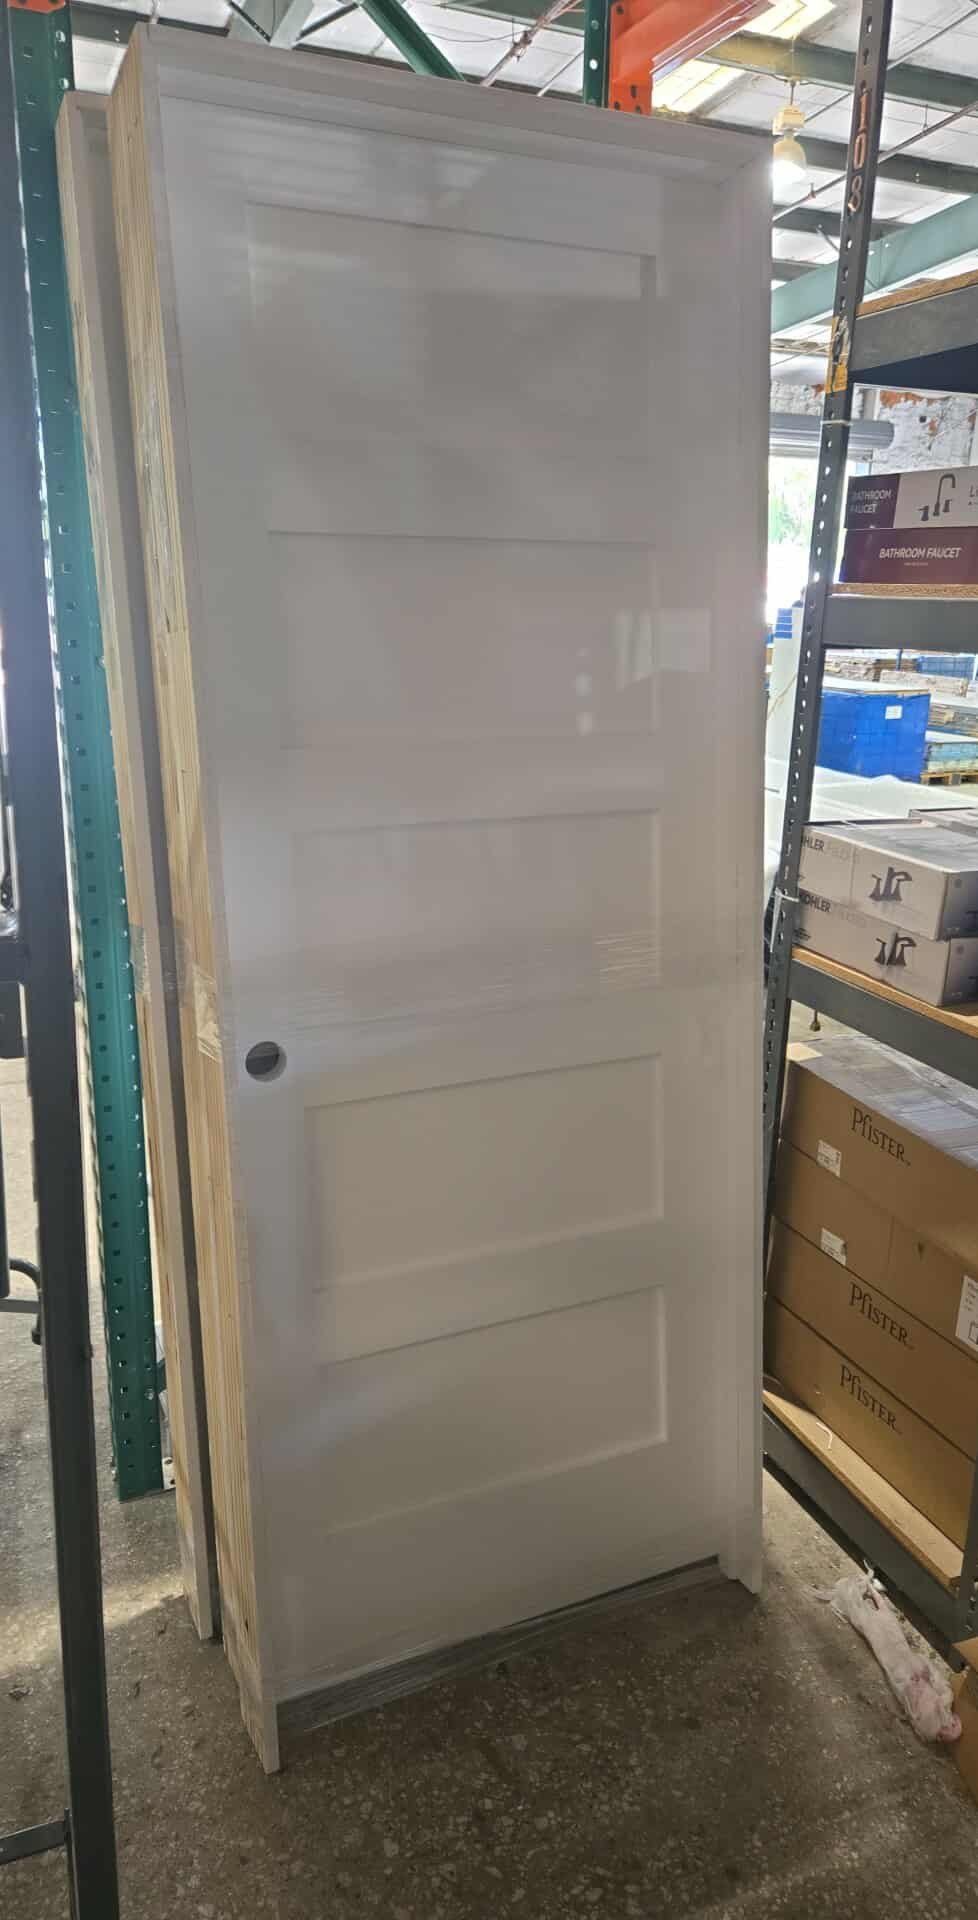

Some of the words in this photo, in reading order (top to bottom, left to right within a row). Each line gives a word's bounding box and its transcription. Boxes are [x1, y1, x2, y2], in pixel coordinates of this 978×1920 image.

[851, 88, 870, 213] 108
[879, 547, 925, 558] BATHROOM
[926, 546, 961, 558] FAUCET
[801, 836, 825, 852] HLER
